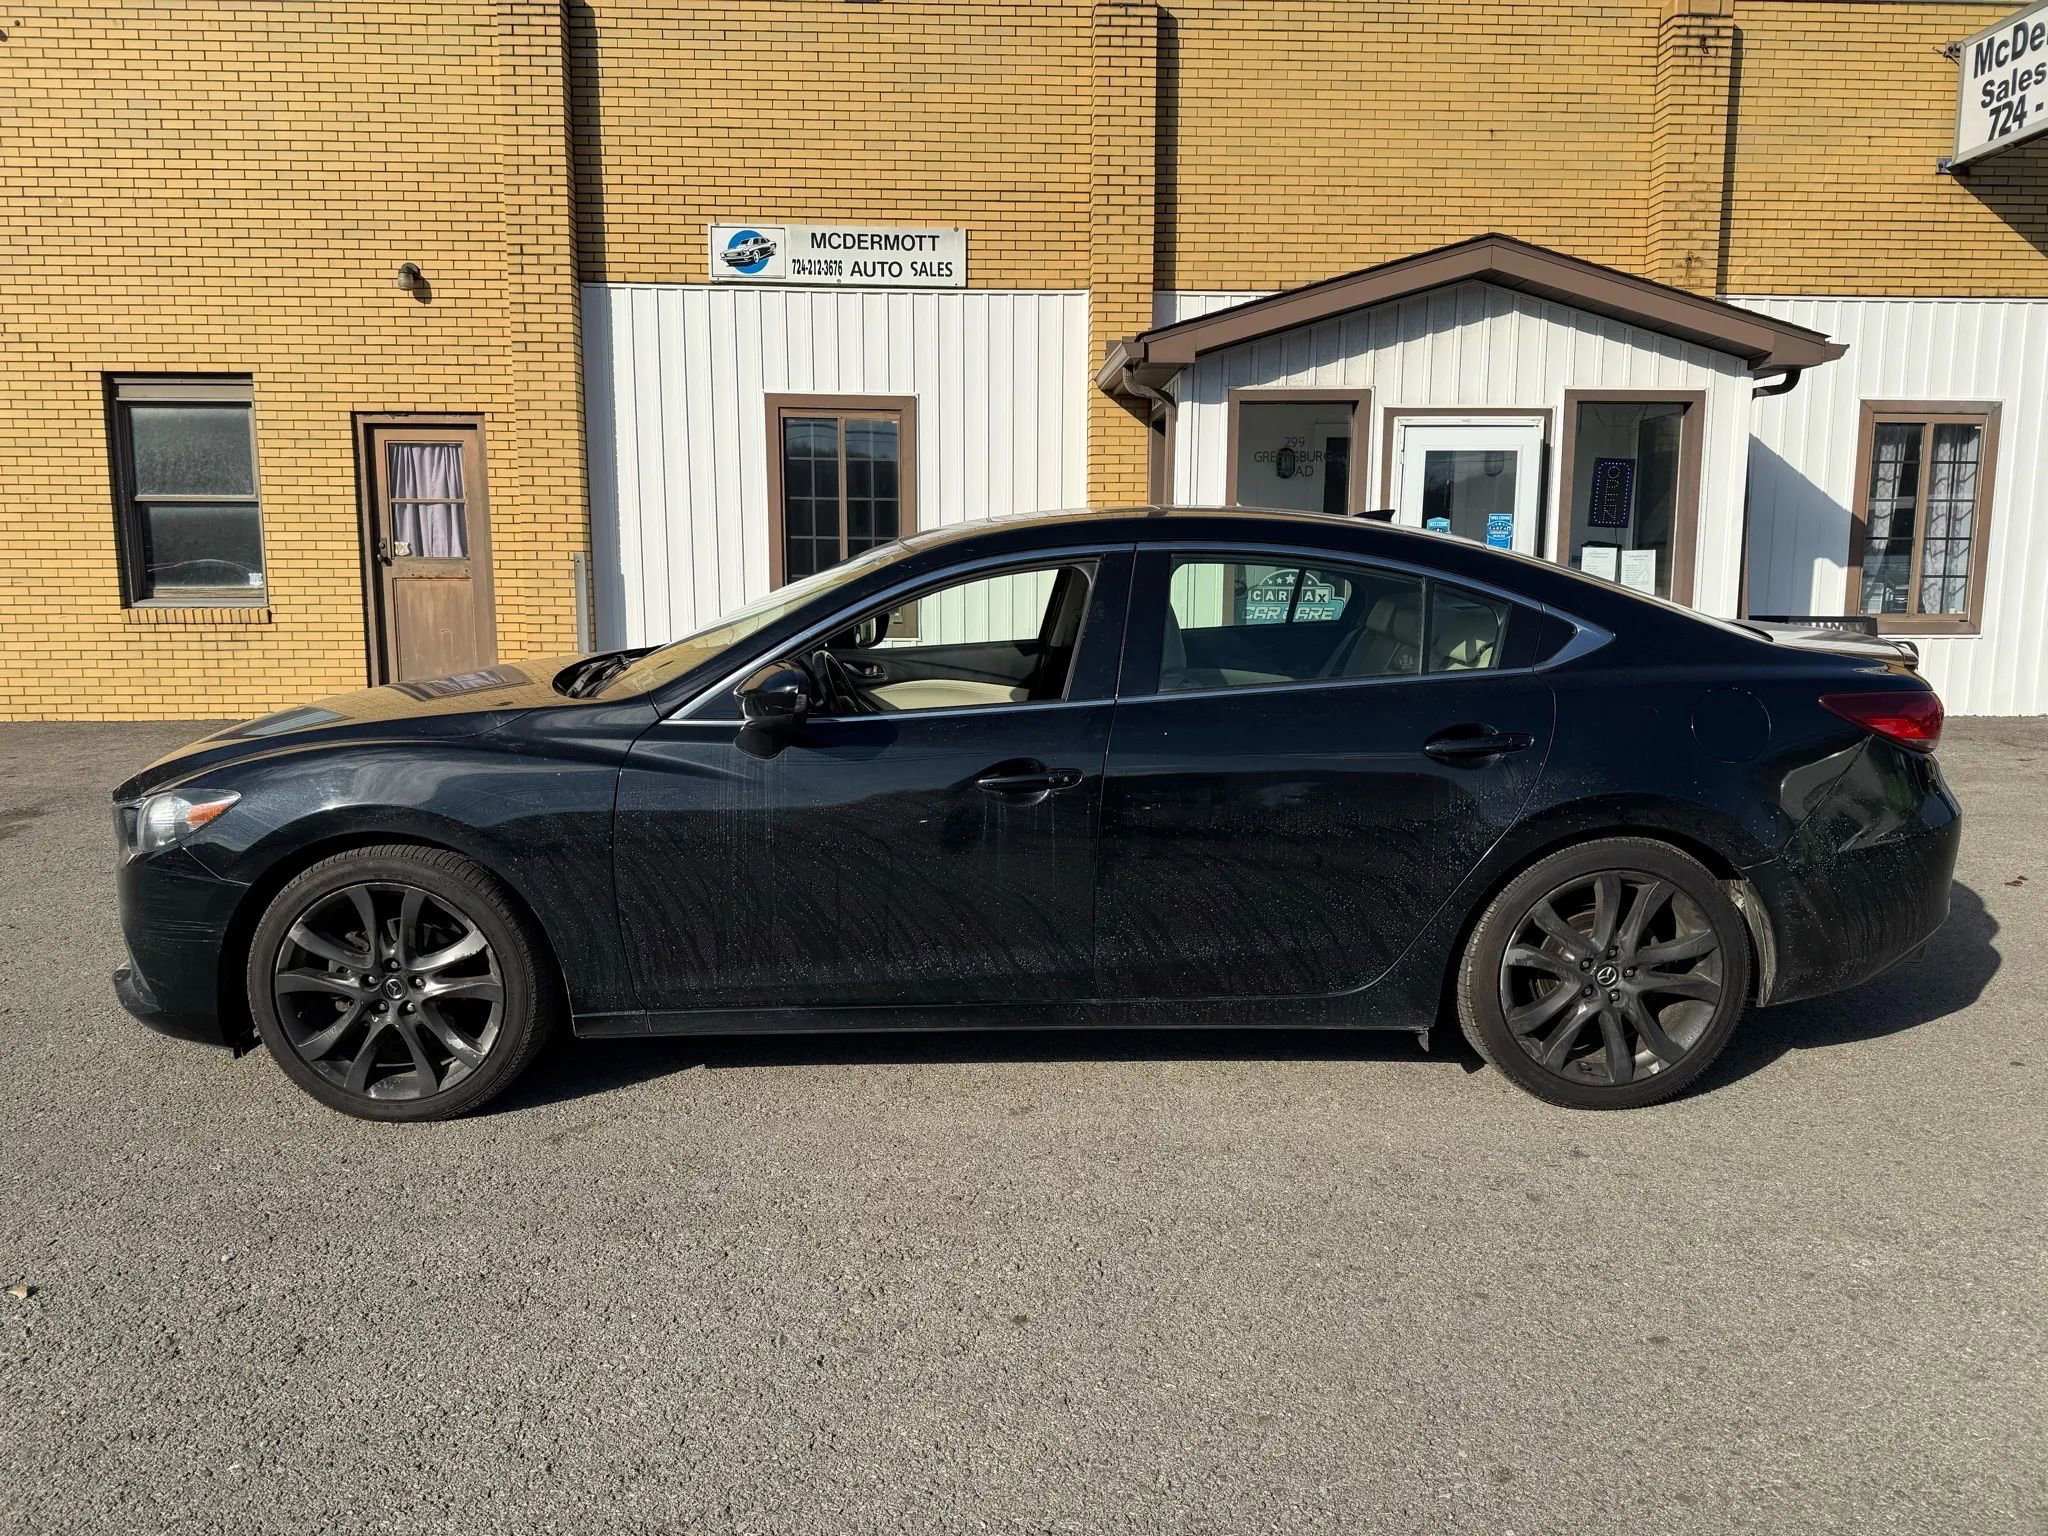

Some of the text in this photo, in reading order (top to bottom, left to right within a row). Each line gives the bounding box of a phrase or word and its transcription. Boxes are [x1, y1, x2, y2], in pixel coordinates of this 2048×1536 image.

[1973, 20, 2048, 79] McDe
[1980, 61, 2047, 109] Sales
[1987, 94, 2028, 142] 724
[810, 232, 940, 252] MCDERMOTT
[791, 258, 843, 277] 724-212-3676
[849, 260, 953, 279] AUTO SALES
[1284, 436, 1305, 448] 299
[1602, 465, 1621, 522] OPEN
[1252, 590, 1327, 603] CARAX
